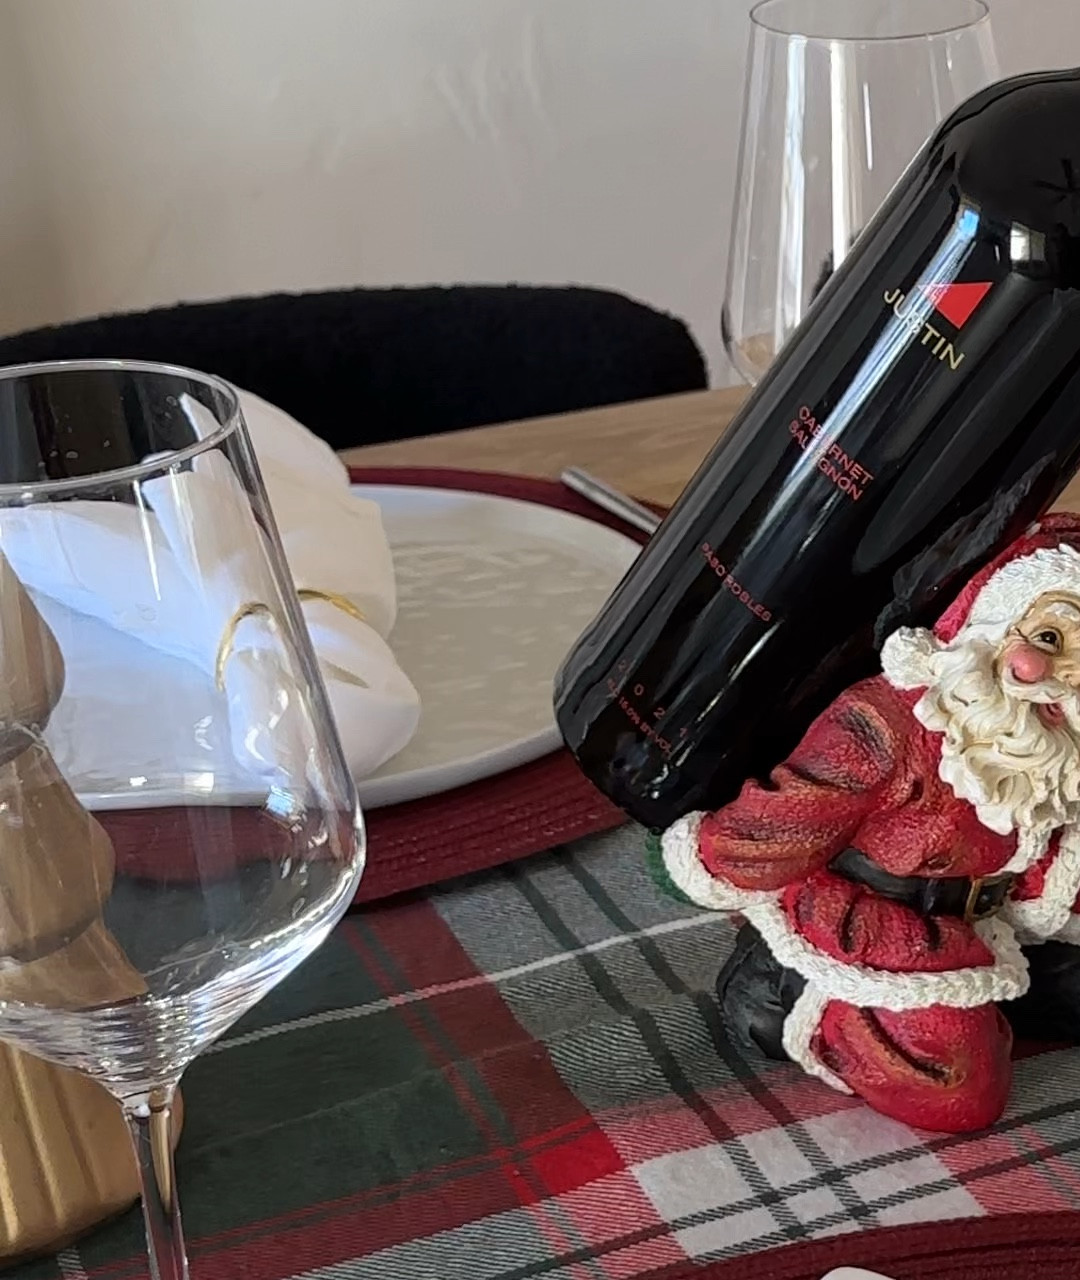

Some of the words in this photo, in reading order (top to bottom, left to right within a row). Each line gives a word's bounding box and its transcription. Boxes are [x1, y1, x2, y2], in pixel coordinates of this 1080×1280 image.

[884, 288, 965, 370] JUSTIN
[789, 420, 863, 500] SAUGNON
[799, 406, 874, 484] CABRNET
[702, 542, 726, 577] PASO
[725, 574, 772, 621] ROBLES
